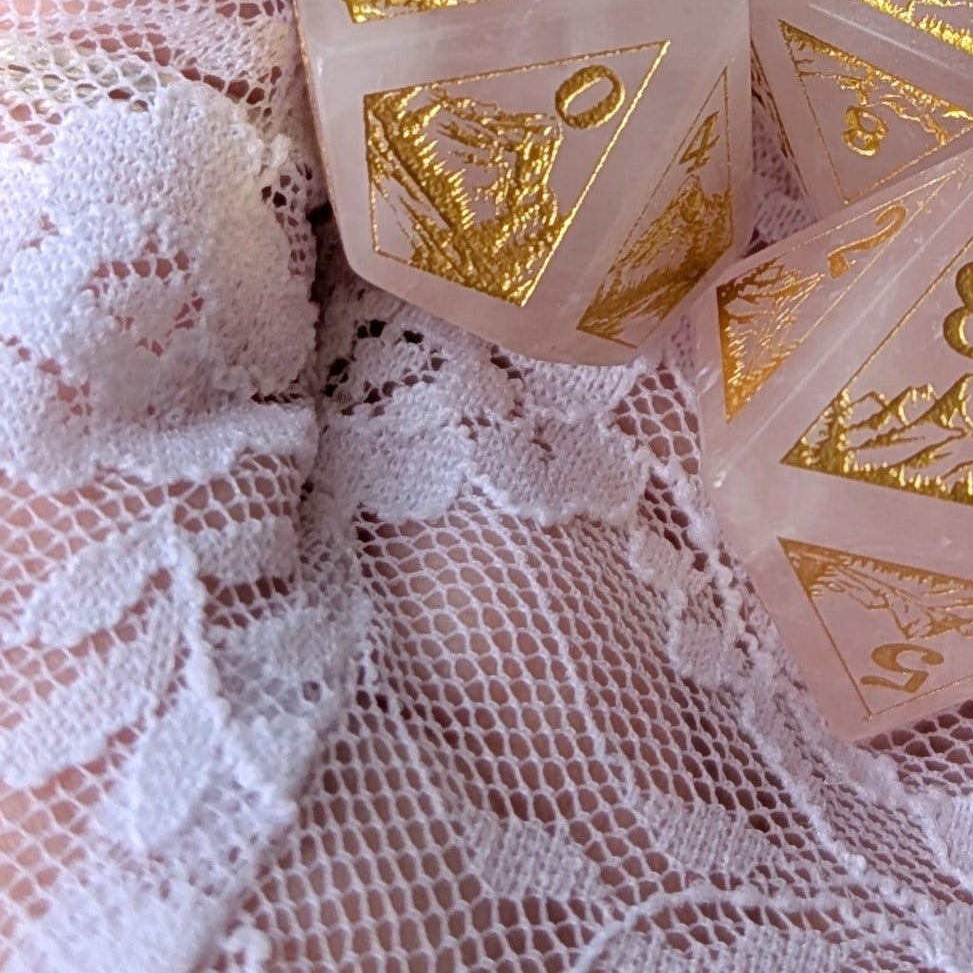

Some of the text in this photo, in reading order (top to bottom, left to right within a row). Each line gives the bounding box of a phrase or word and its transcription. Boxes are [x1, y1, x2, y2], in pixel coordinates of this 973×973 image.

[554, 64, 626, 130] 0
[678, 110, 719, 174] 4
[842, 105, 890, 158] 8
[860, 641, 946, 695] 5
